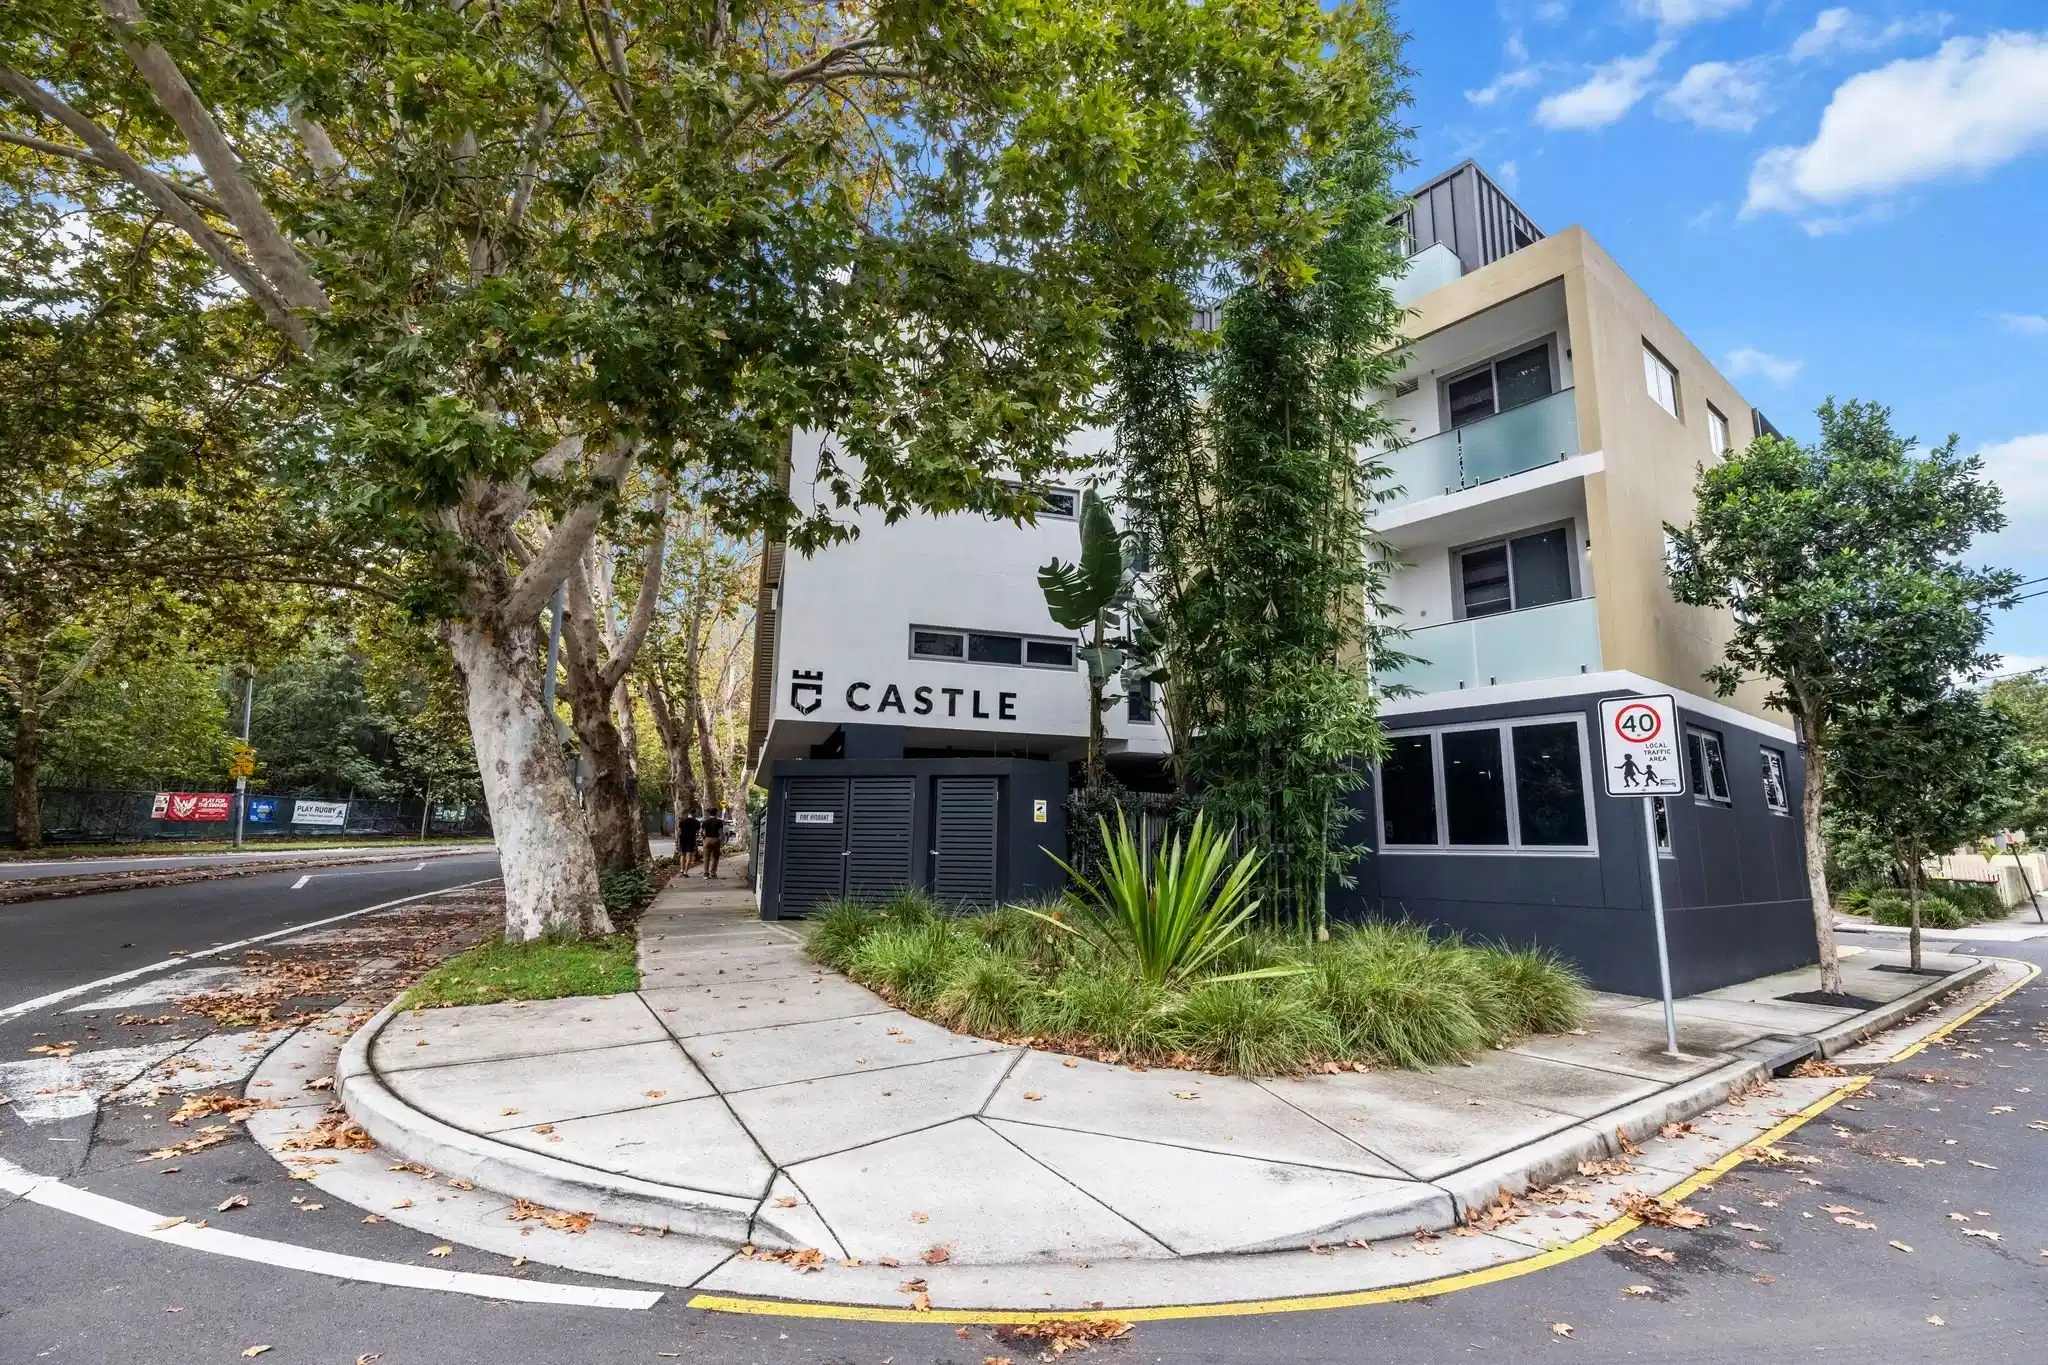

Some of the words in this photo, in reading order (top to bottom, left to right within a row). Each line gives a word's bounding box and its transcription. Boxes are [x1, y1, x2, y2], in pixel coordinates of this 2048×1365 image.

[845, 681, 1017, 720] CASTLE
[1621, 713, 1654, 733] 40
[314, 806, 337, 814] RUGBY
